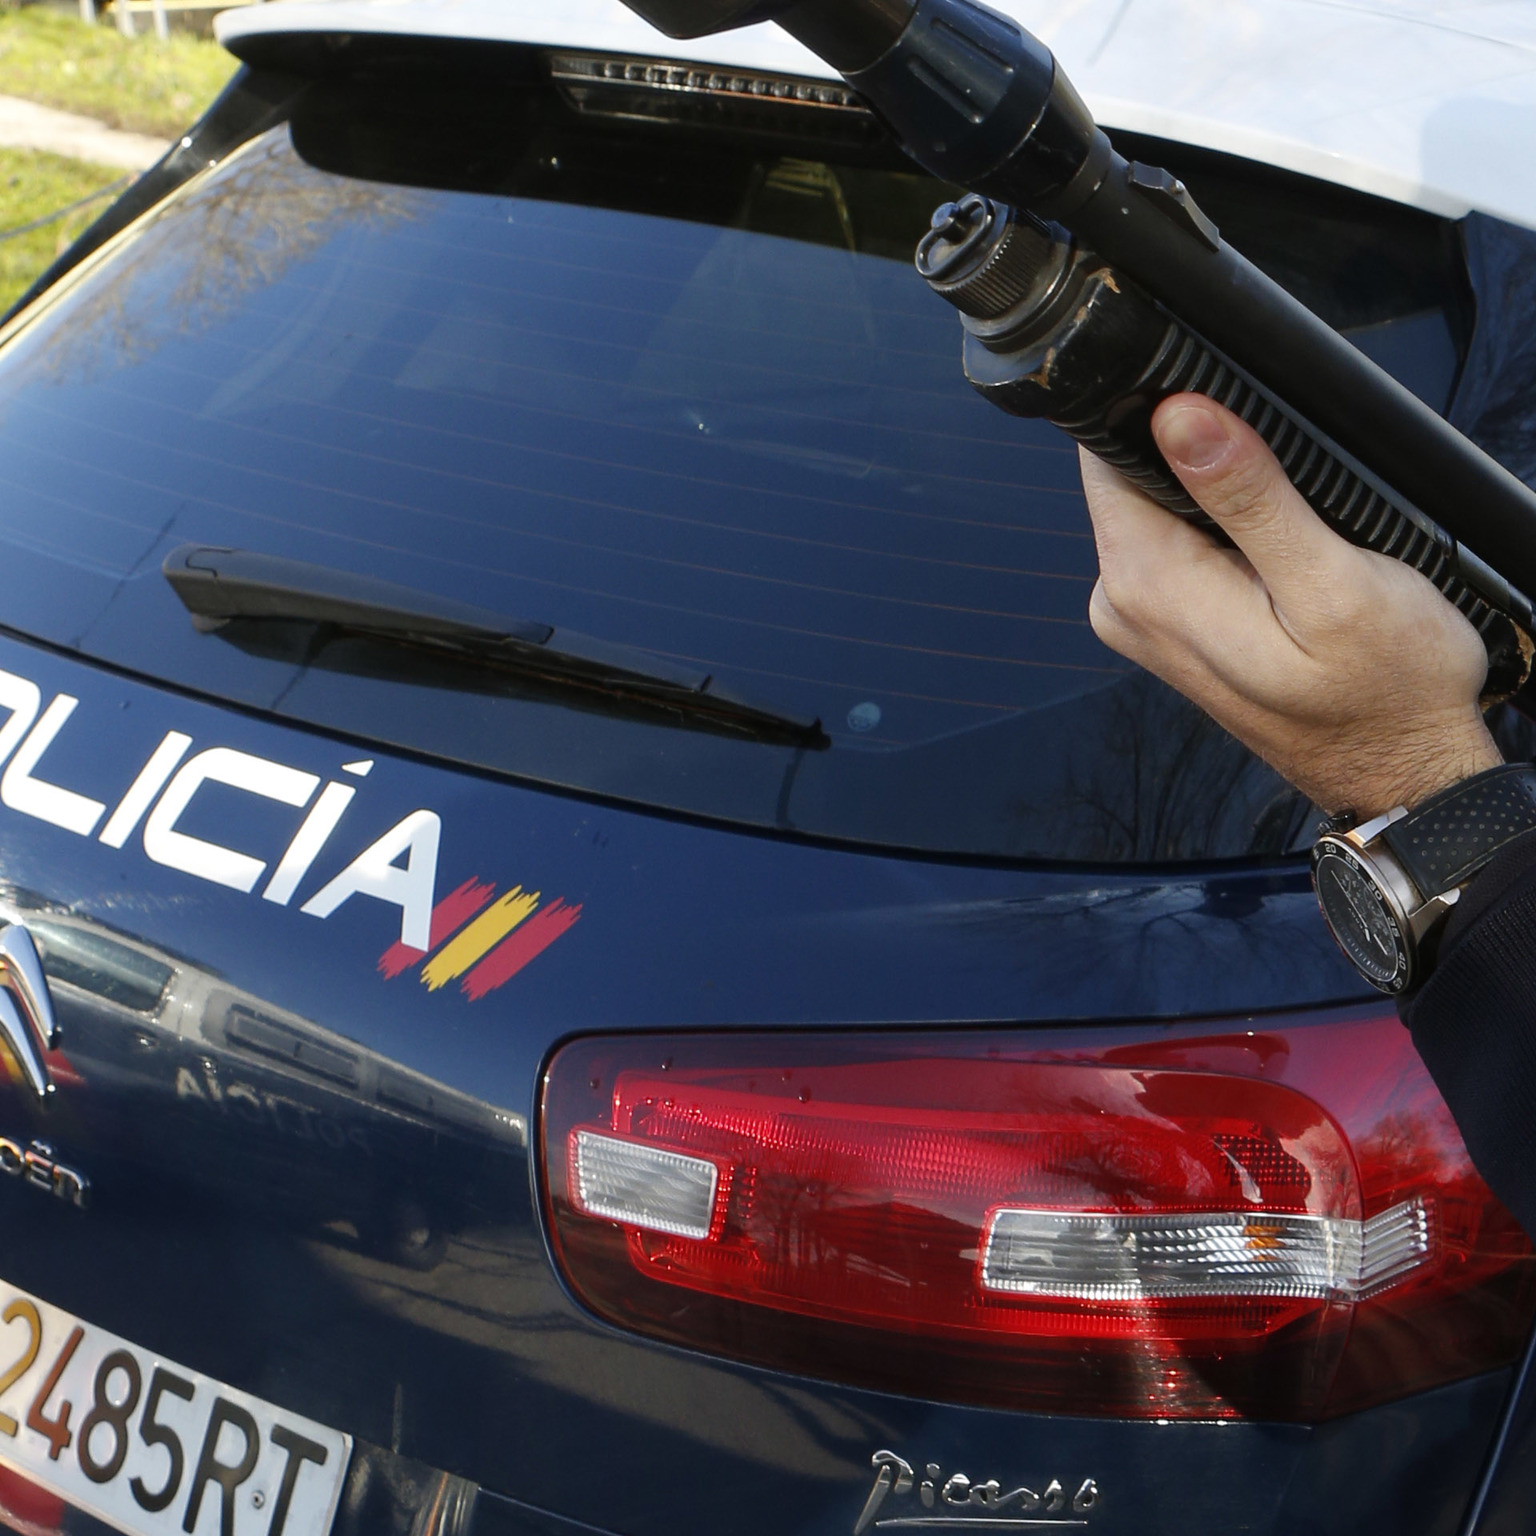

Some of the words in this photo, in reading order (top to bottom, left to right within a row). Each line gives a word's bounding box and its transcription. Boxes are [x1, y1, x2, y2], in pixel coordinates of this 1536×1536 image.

[1325, 843, 1336, 854] 20
[1345, 853, 1358, 870] 25
[1368, 881, 1383, 900] 30
[1399, 951, 1407, 970] 40
[854, 1449, 1098, 1536] Picasso
